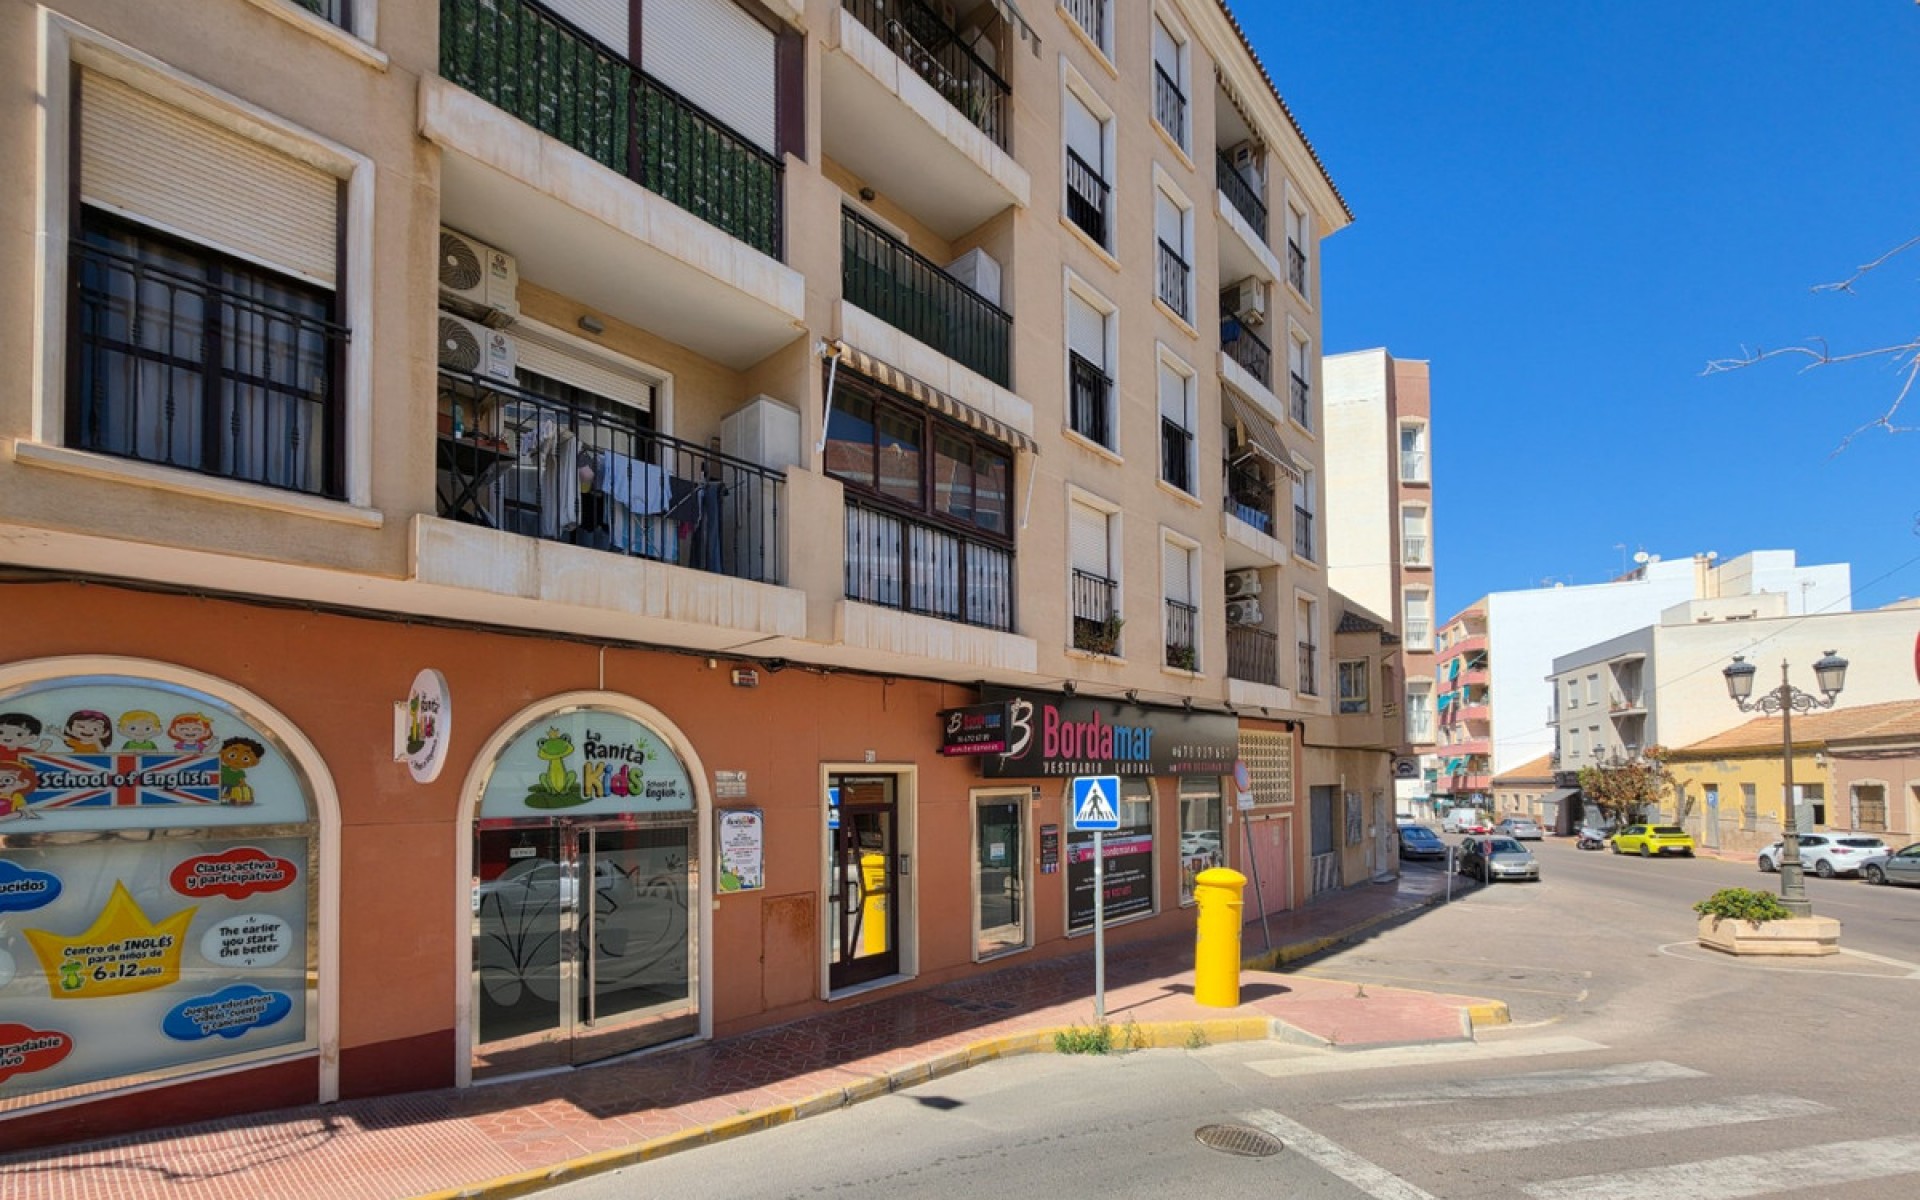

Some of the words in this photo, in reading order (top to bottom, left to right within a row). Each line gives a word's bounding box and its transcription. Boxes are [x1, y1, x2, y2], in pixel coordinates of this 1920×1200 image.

[586, 728, 602, 741] La
[1043, 704, 1153, 761] Bordamar
[584, 740, 645, 765] Ranita
[41, 772, 108, 787] School
[114, 772, 138, 787] of
[142, 771, 212, 790] English
[583, 760, 644, 798] Kids
[646, 788, 677, 801] English
[196, 862, 232, 873] Clases
[236, 861, 276, 871] activas
[188, 877, 196, 888] y
[200, 871, 283, 886] participativas
[219, 926, 239, 937] The
[242, 922, 281, 934] earlier
[63, 945, 105, 957] Centro
[107, 943, 121, 953] de
[221, 937, 243, 948] you
[87, 954, 116, 966] para
[149, 949, 163, 958] de
[219, 947, 240, 958] the
[242, 944, 279, 955] better
[93, 965, 107, 981] 6
[109, 971, 116, 979] a
[119, 962, 138, 978] 12
